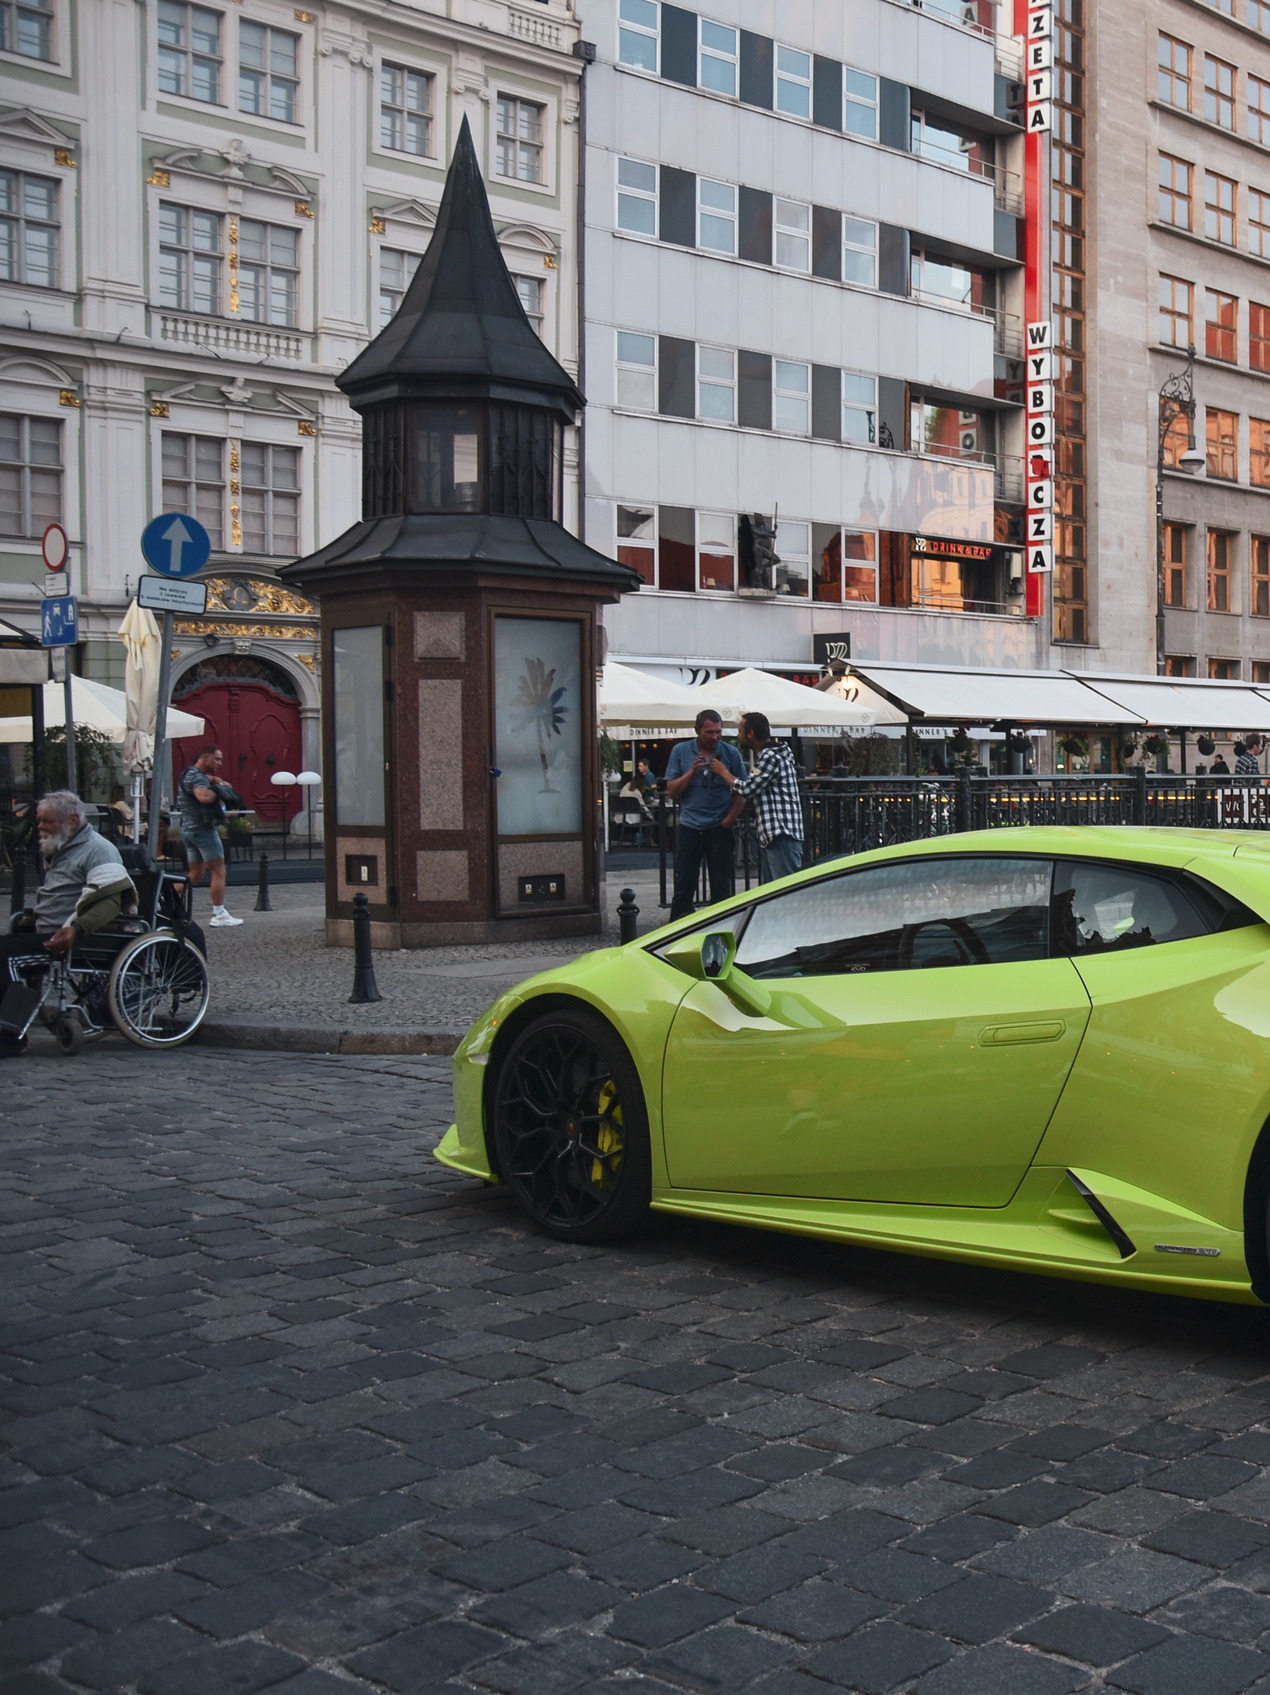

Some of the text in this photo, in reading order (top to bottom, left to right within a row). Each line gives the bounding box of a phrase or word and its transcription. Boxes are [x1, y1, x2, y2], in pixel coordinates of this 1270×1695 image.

[1028, 0, 1047, 568] ZETA WYBOCZA
[932, 541, 962, 554] DRINK
[973, 547, 992, 557] BAR
[630, 728, 655, 736] DINNER
[803, 725, 836, 734] DINNER
[915, 728, 941, 736] INNER
